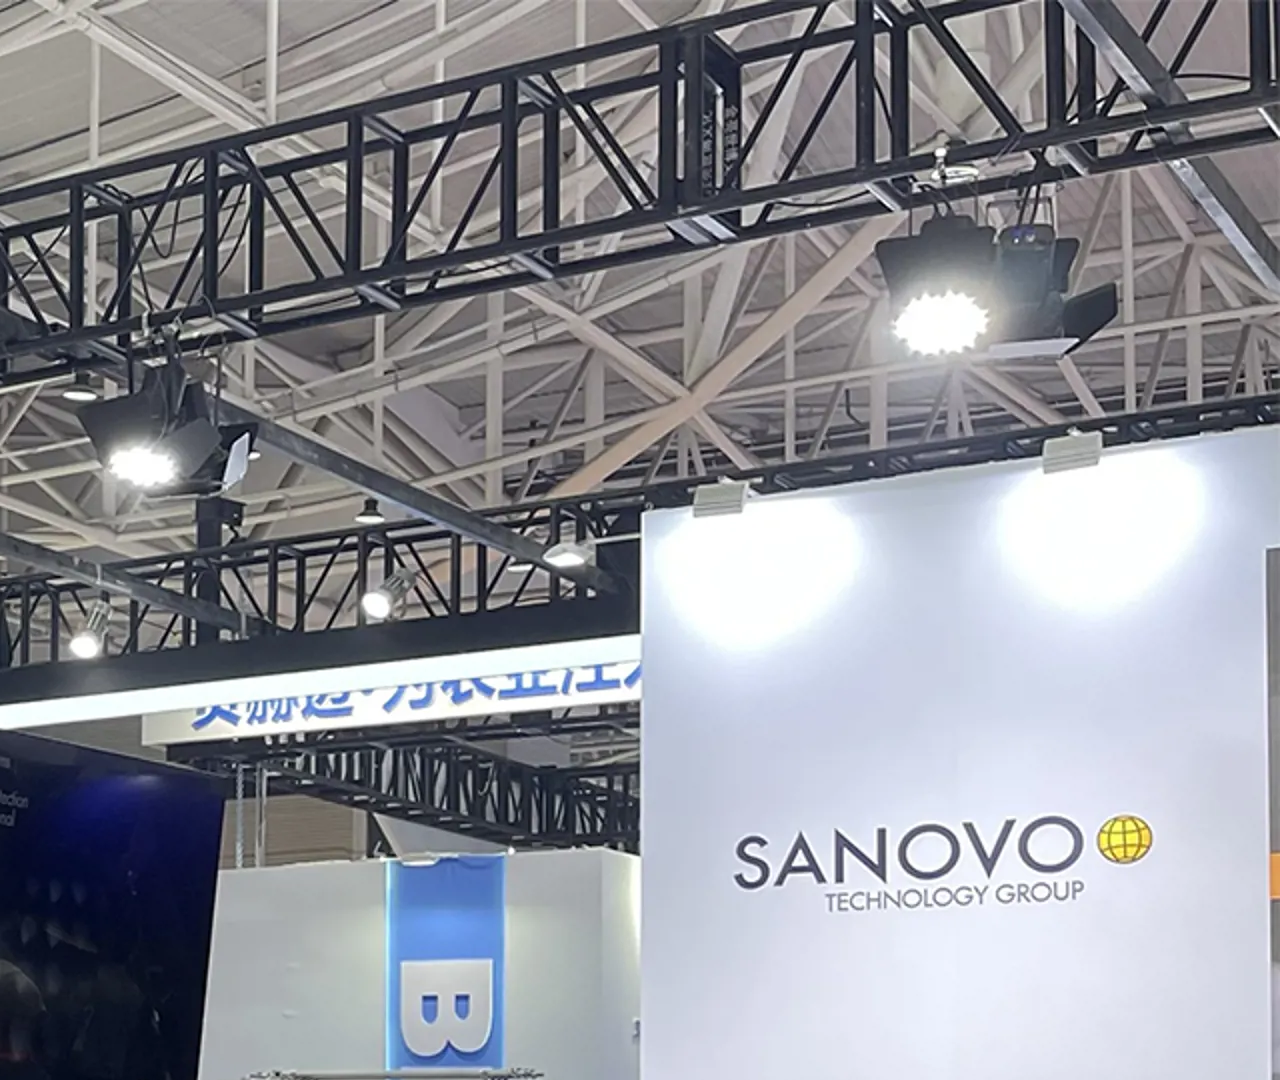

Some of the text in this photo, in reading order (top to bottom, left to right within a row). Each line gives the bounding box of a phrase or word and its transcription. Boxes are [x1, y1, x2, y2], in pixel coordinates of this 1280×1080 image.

[733, 815, 1085, 890] SANOVO
[825, 881, 1085, 913] TECHNOLOGY GROUP
